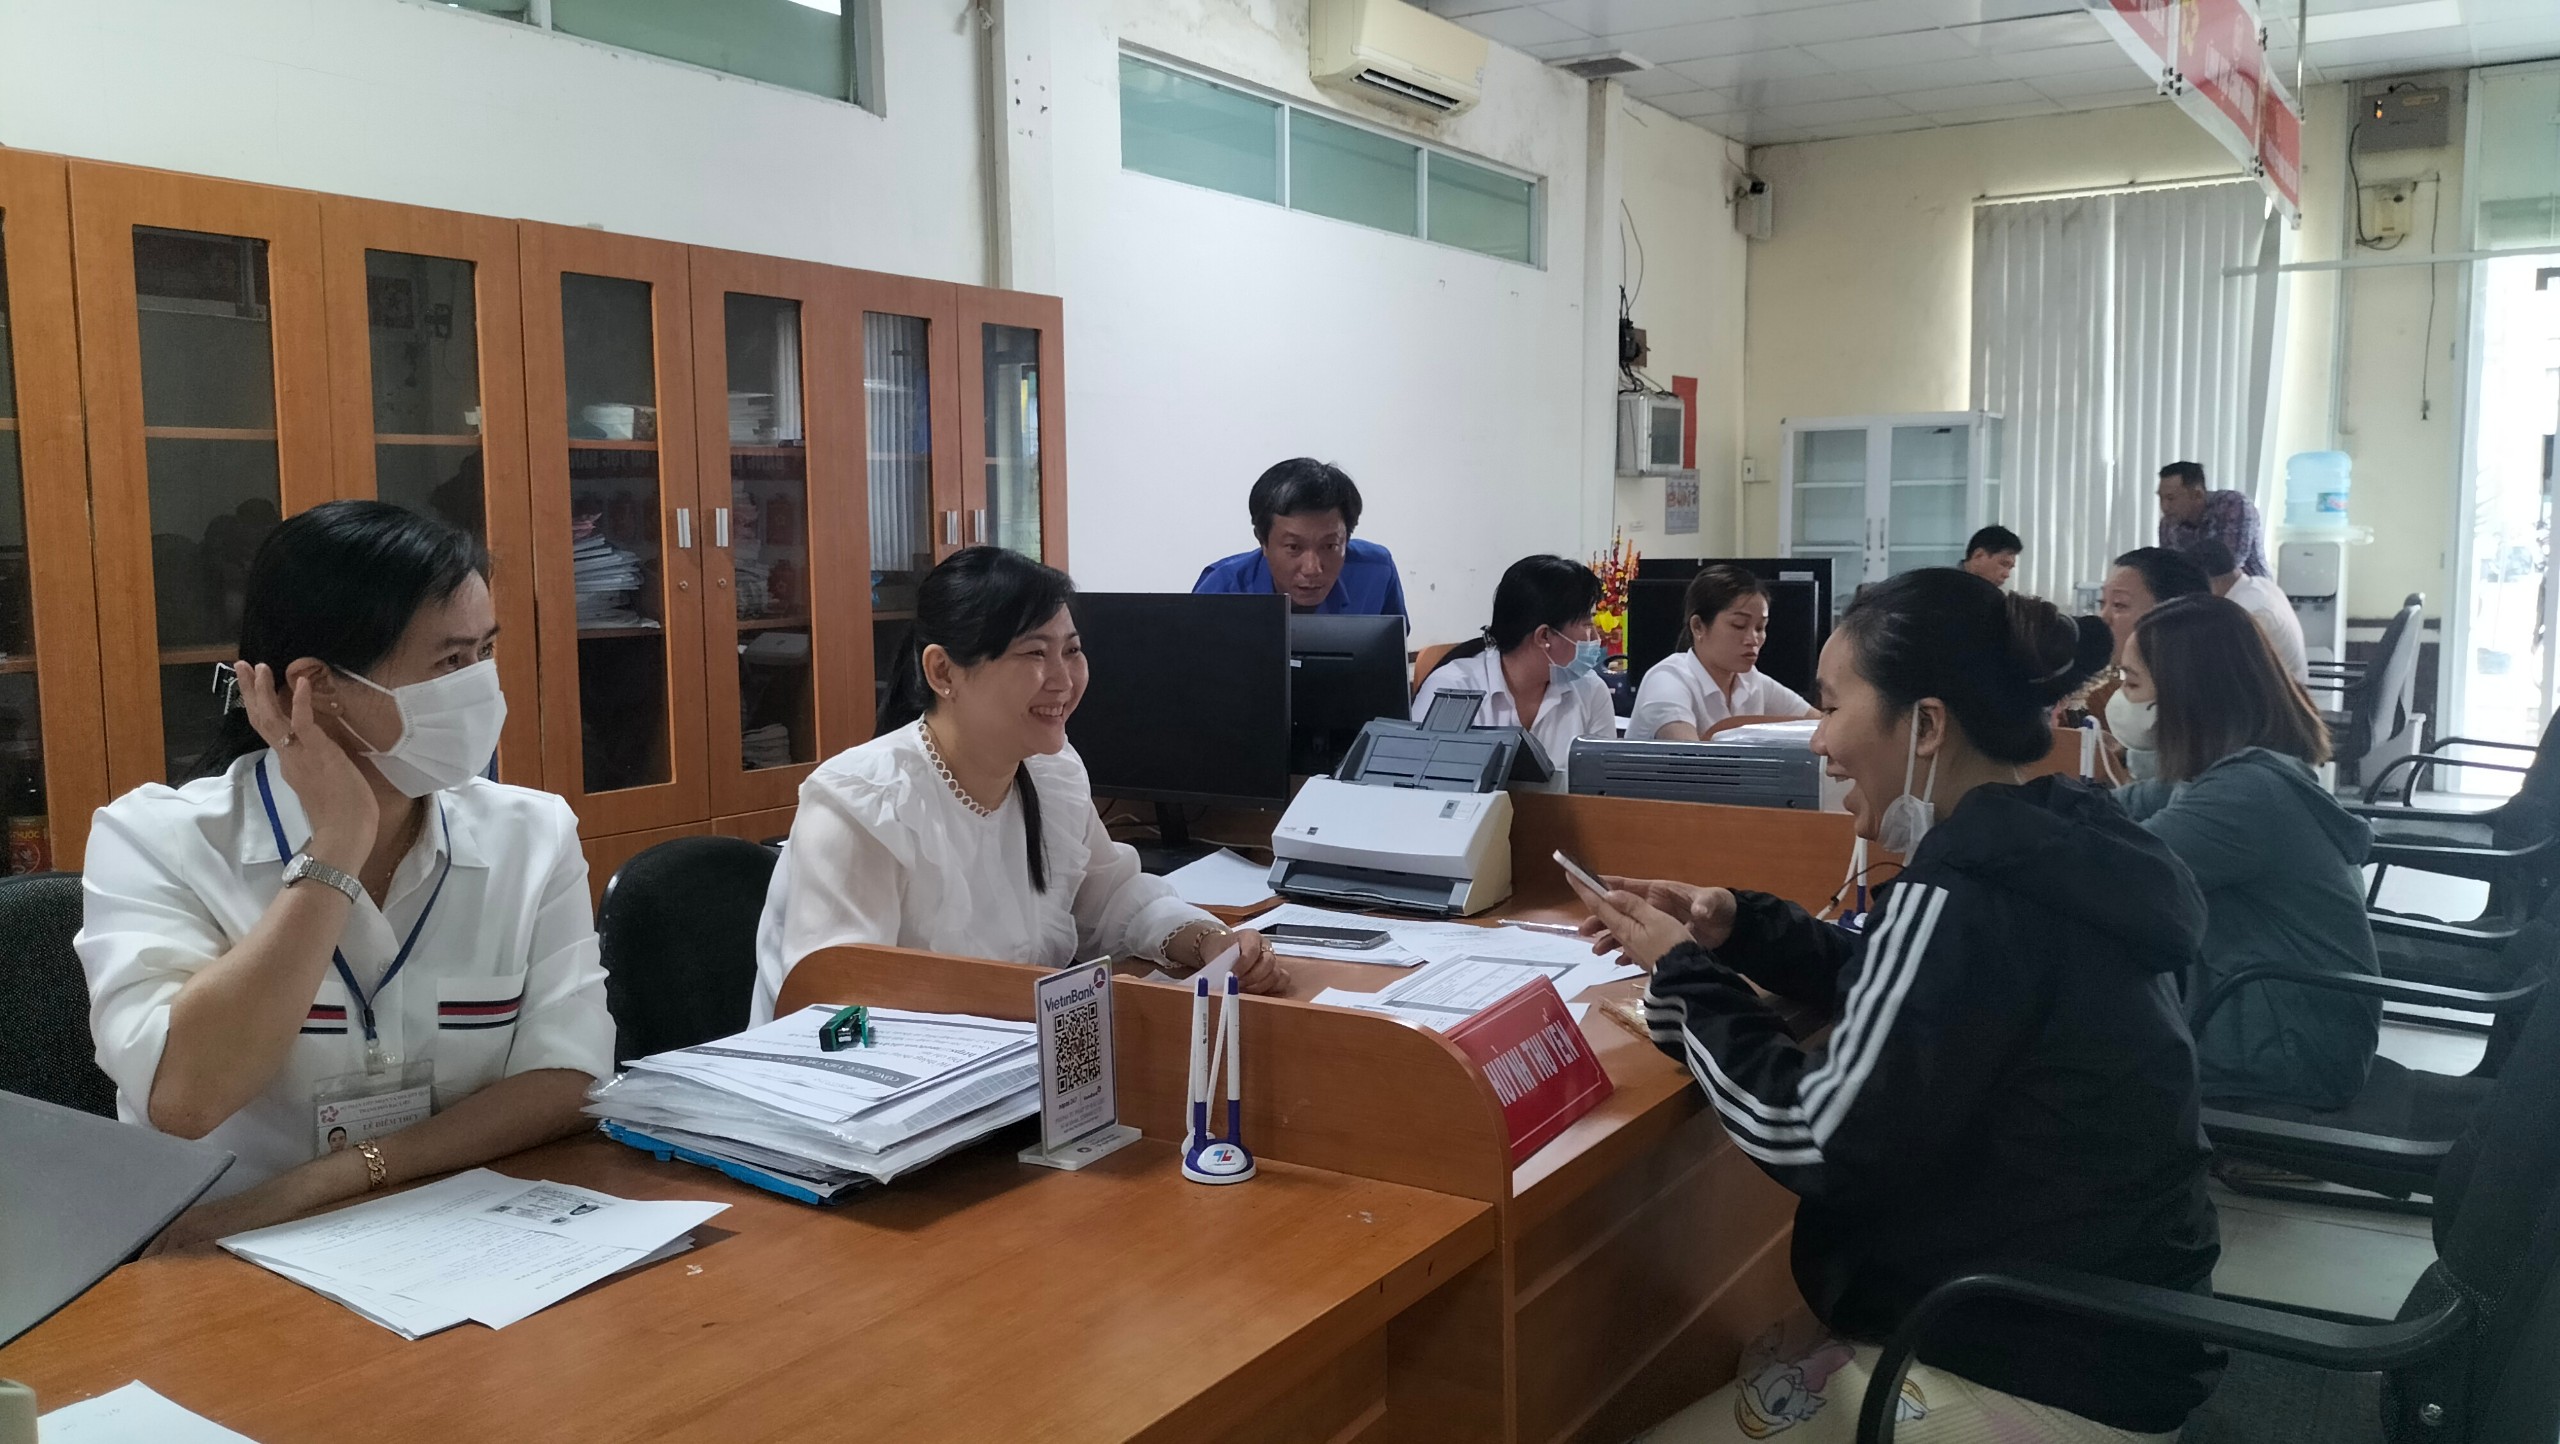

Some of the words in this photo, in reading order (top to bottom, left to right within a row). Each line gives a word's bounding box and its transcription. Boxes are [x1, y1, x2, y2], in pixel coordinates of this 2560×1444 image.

[1044, 984, 1095, 1012] VietinBank
[1482, 1045, 1538, 1108] HUỲNH
[1520, 1033, 1559, 1081] THU
[1541, 1008, 1580, 1067] YẾN
